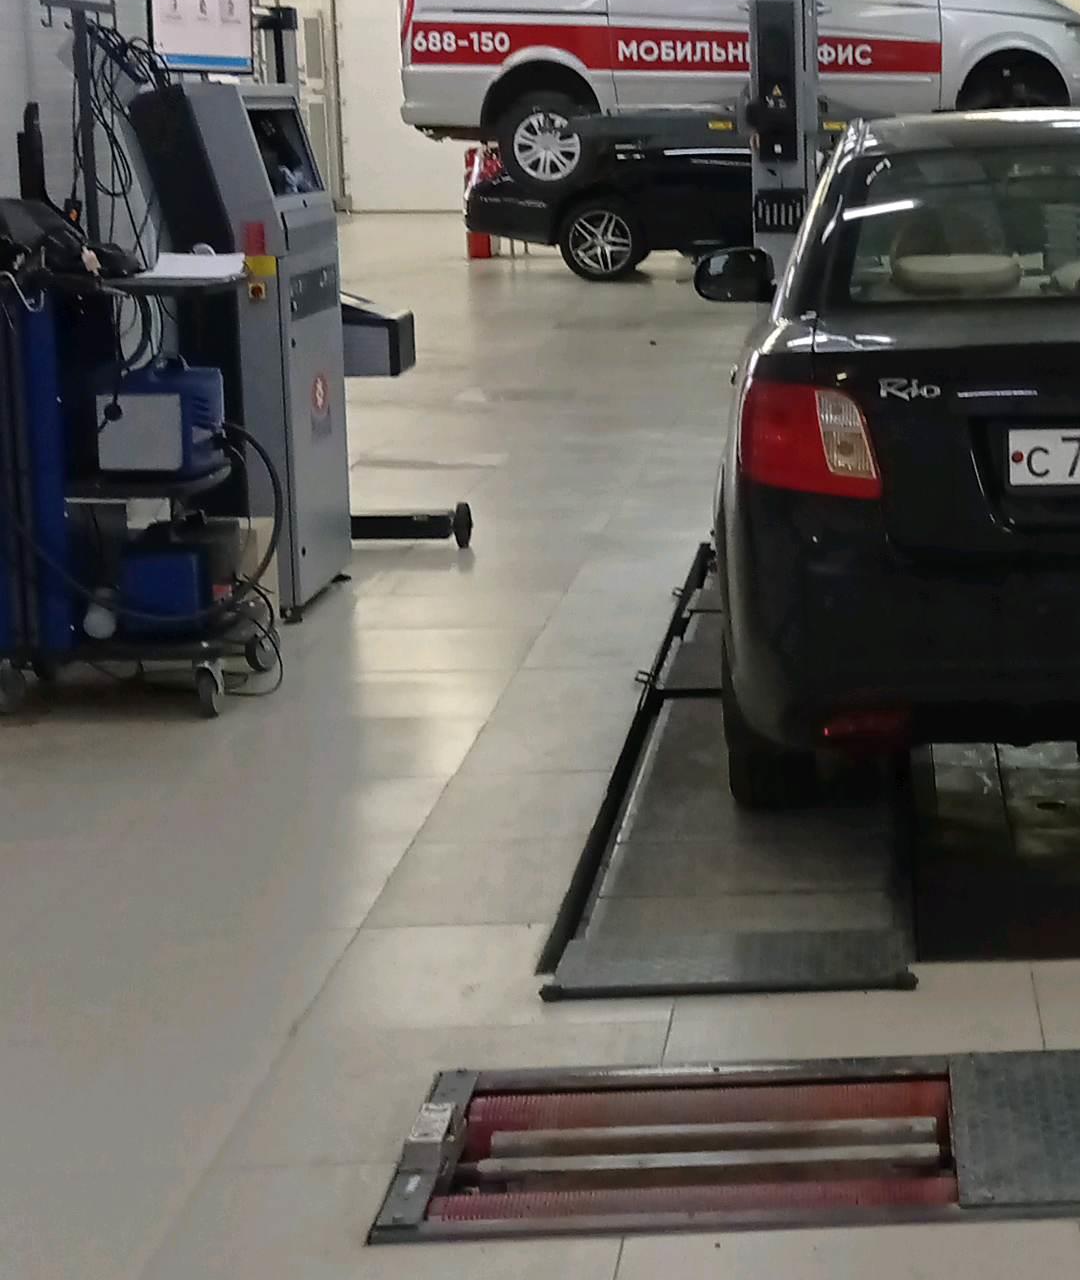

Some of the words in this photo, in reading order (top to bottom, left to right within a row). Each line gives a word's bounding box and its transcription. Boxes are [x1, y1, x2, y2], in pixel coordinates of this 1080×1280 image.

[413, 30, 511, 54] 688-150
[617, 38, 749, 64] МОБИЛЬН
[817, 42, 873, 66] ФИС
[879, 376, 942, 402] Rio
